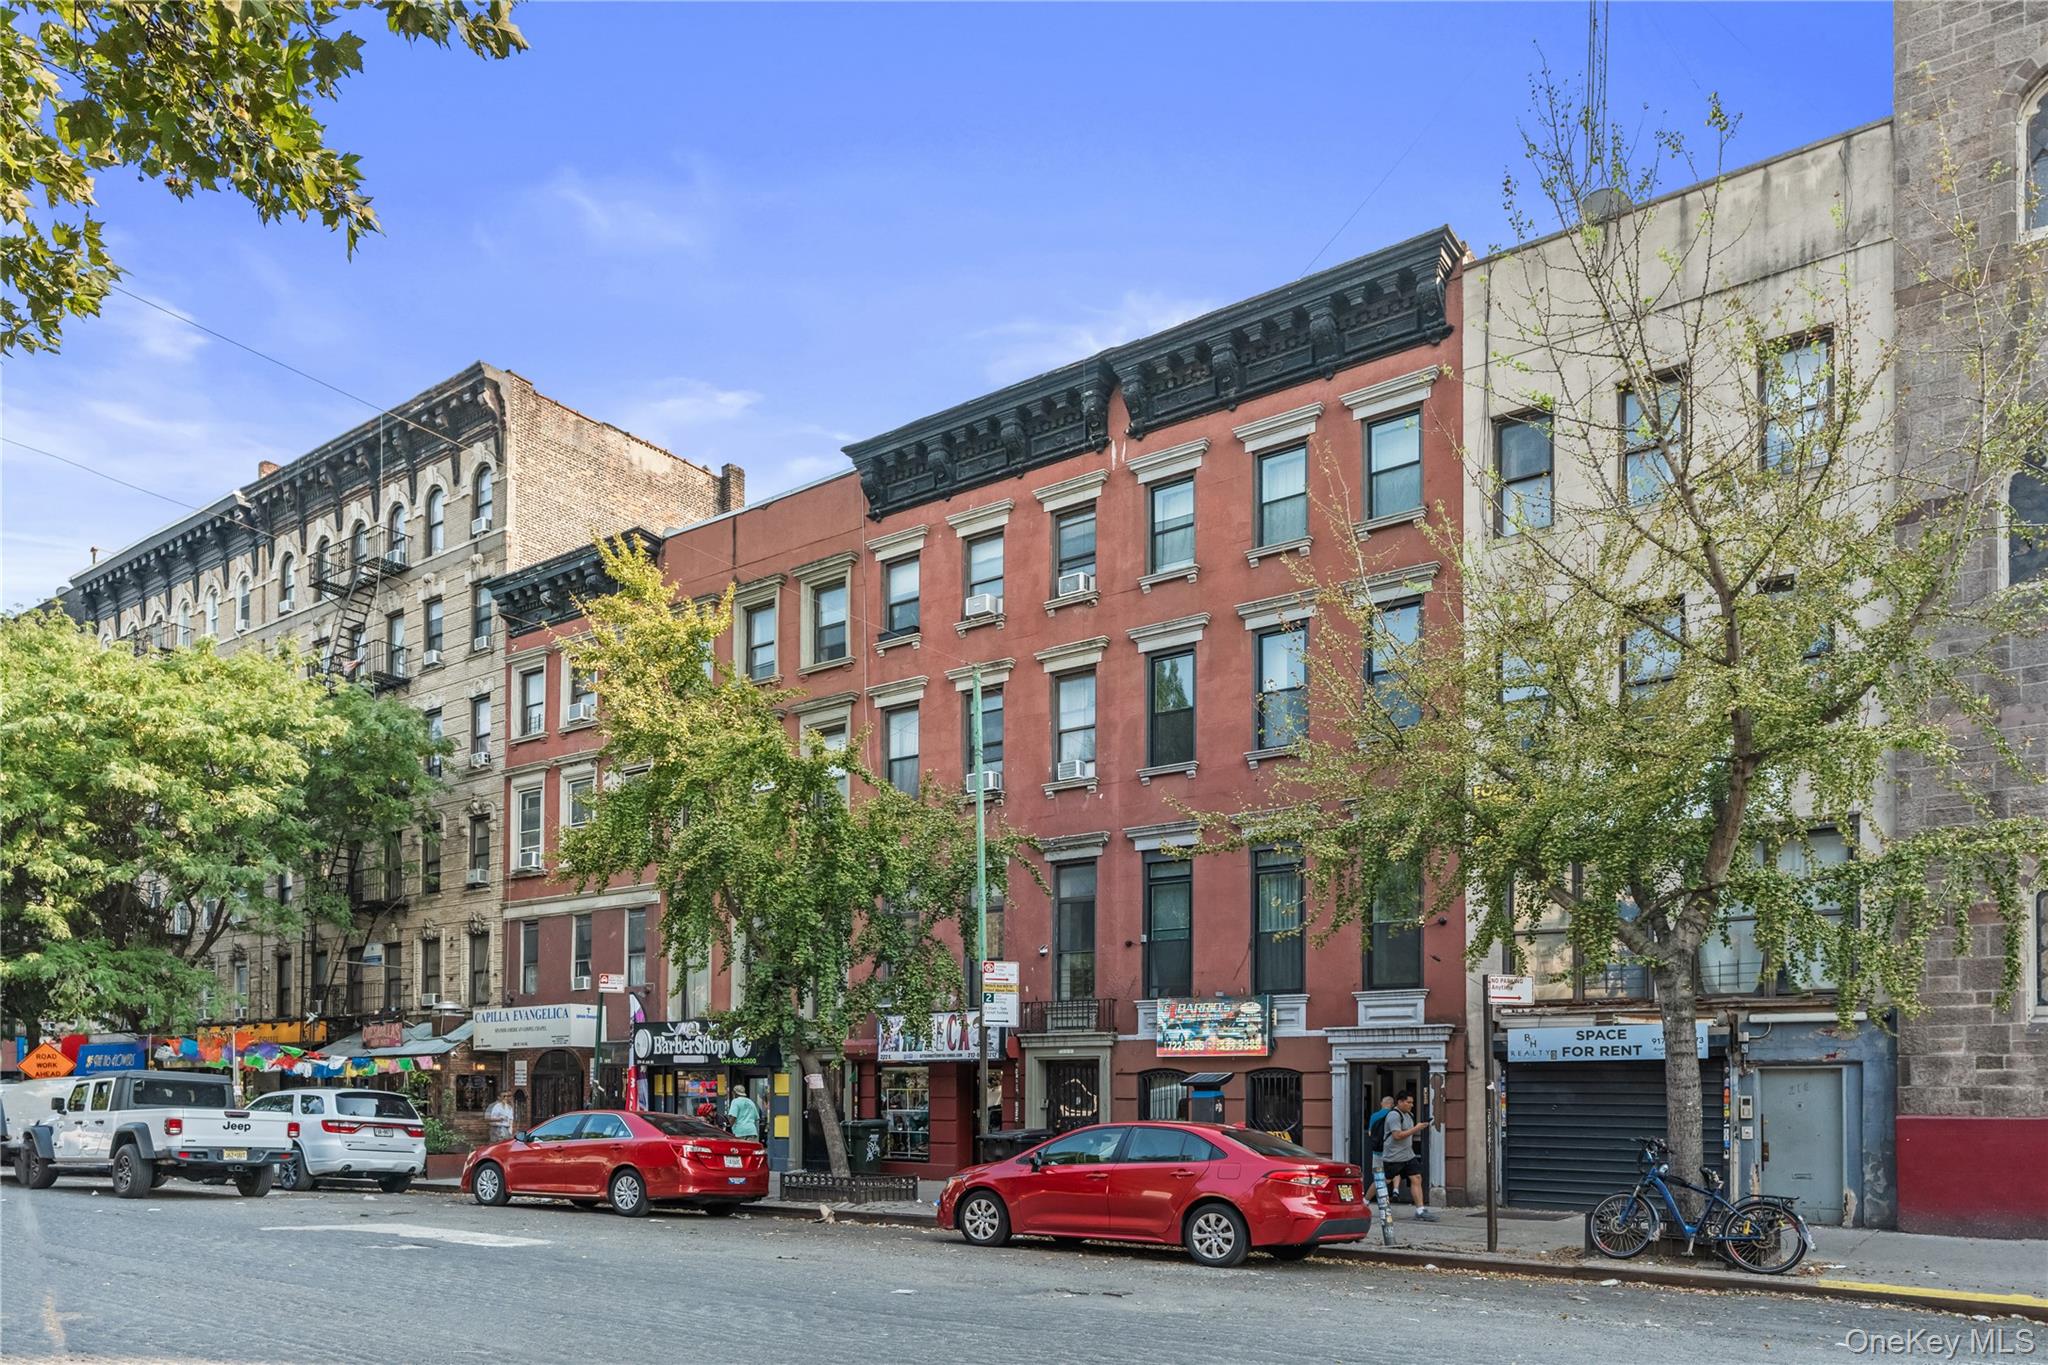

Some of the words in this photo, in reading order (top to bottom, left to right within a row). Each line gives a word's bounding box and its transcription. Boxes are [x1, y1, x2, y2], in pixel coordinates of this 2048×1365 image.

[985, 993, 992, 1002] 2
[474, 1010, 510, 1024] CAPILLA
[513, 1007, 569, 1022] EVANGELICA
[1576, 1029, 1628, 1041] SPACE
[1562, 1046, 1596, 1058] FOR
[1599, 1045, 1643, 1057] RENT
[34, 1070, 61, 1078] AHEAD
[222, 1121, 251, 1132] Jeep
